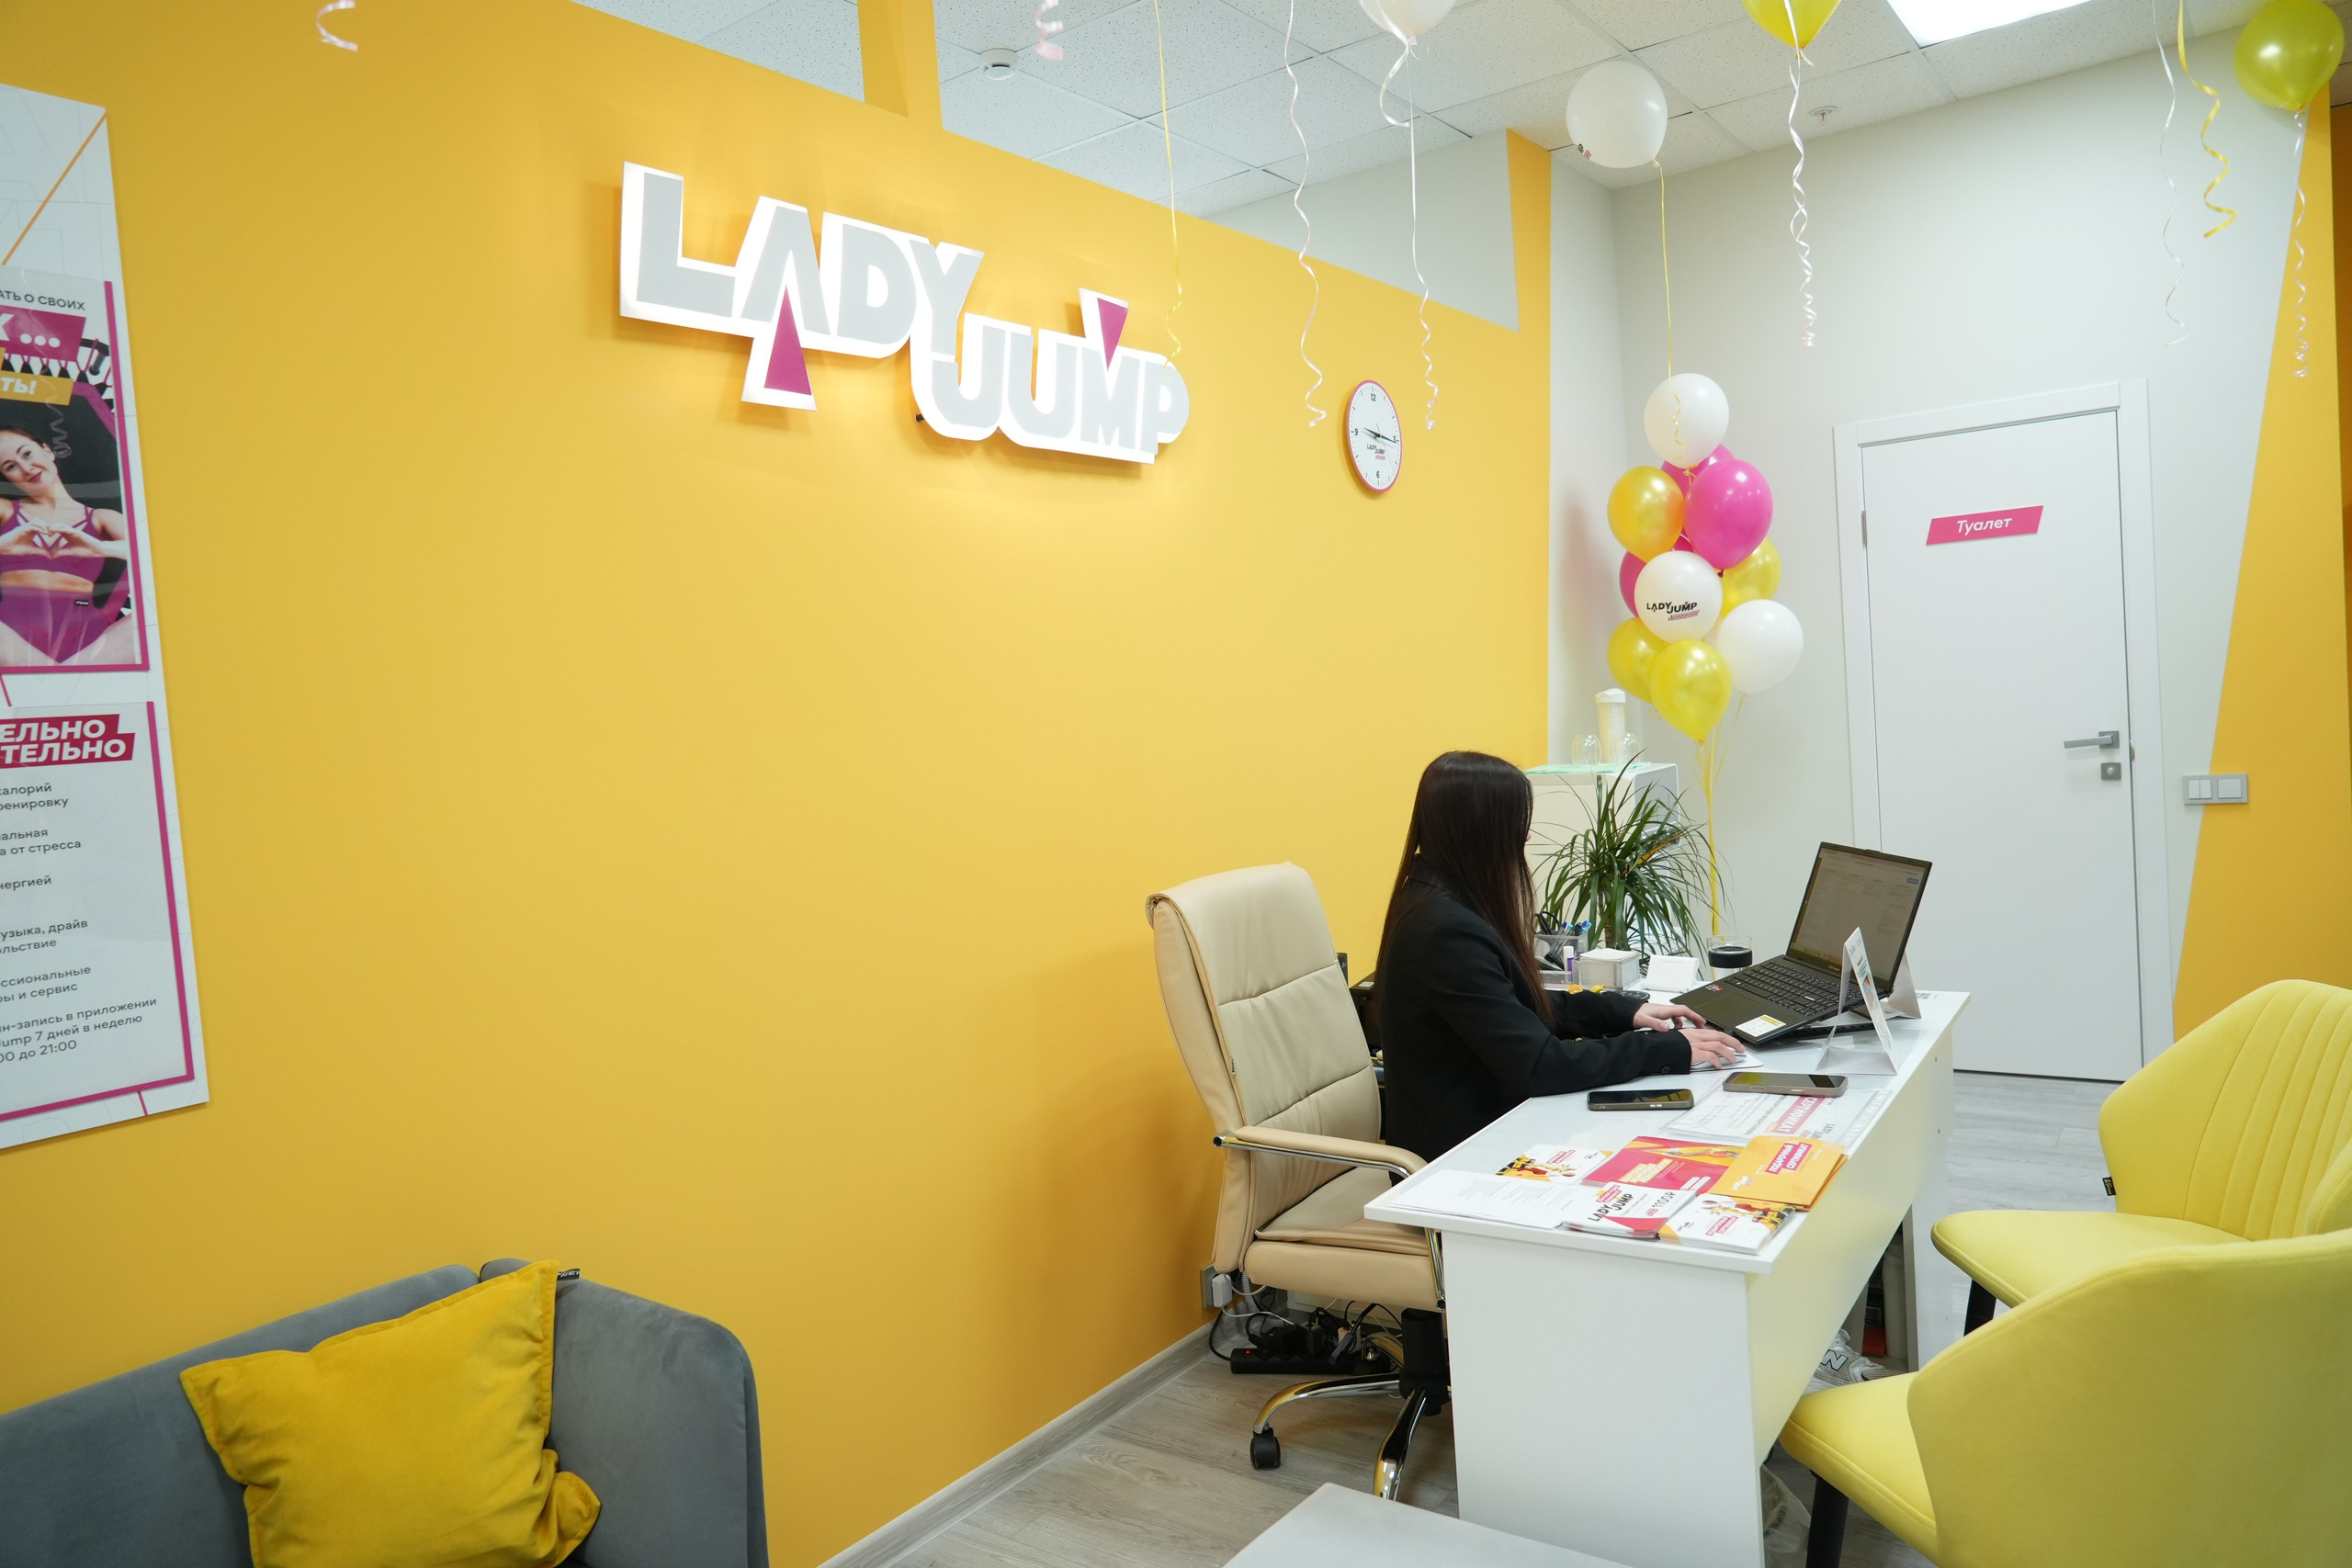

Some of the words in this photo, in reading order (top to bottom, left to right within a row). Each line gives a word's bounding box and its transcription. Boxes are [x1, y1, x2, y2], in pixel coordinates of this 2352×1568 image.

[24, 293, 35, 303] О
[37, 295, 85, 310] СВОИХ
[634, 168, 986, 399] LADY
[926, 296, 1191, 457] JUMP
[0, 377, 38, 395] ТЬ!
[1370, 393, 1376, 401] 12
[1375, 470, 1380, 479] 6
[1956, 517, 2013, 536] Туалет
[1645, 601, 1672, 613] LADY
[1666, 601, 1698, 615] JUMP
[0, 739, 127, 764] ТЕЛЬНО
[10, 846, 26, 855] от
[28, 840, 82, 854] стресса
[48, 919, 88, 934] драйв
[18, 991, 27, 1000] и
[30, 983, 78, 998] сервис
[66, 1012, 74, 1021] в
[76, 998, 157, 1020] приложении
[34, 1031, 43, 1042] 7
[46, 1024, 80, 1041] дней
[83, 1023, 91, 1032] в
[94, 1014, 142, 1031] неделю
[18, 1049, 37, 1062] до
[39, 1039, 78, 1055] 21:00
[1587, 1202, 1613, 1223] LADY
[1611, 1192, 1634, 1212] JUMP
